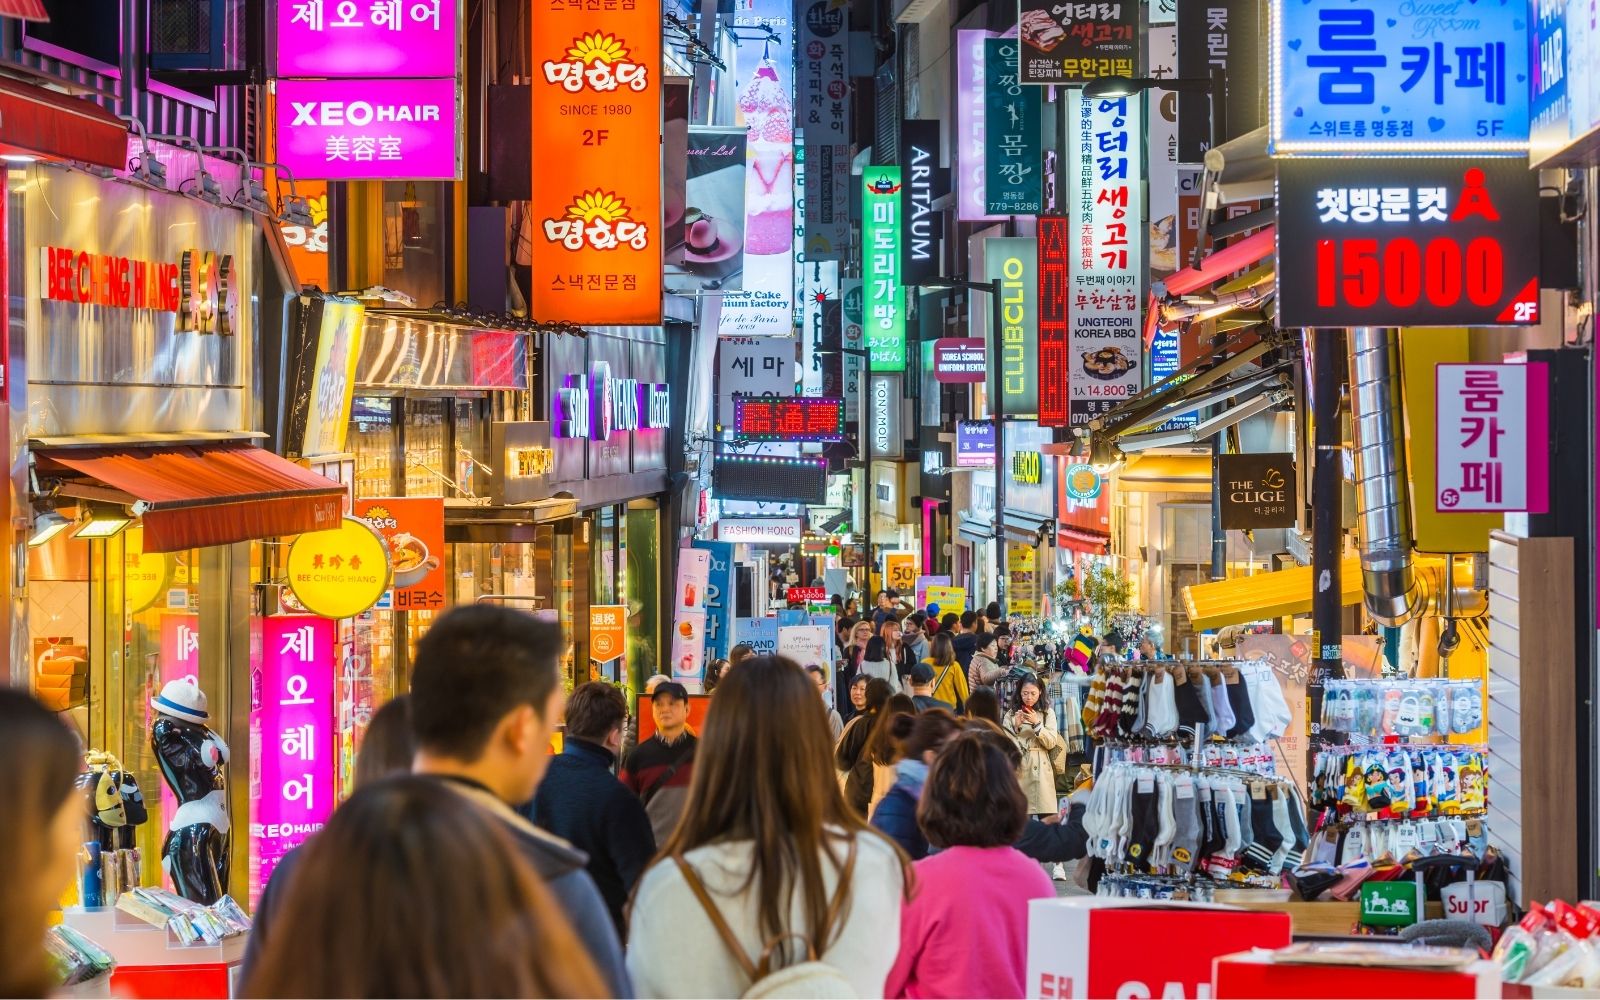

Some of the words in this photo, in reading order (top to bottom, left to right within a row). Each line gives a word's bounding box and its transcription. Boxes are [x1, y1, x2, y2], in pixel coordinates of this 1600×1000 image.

[290, 0, 441, 31] 제오헤어
[1052, 3, 1121, 26] 엉터리
[1071, 23, 1133, 47] 생고기
[1306, 9, 1387, 105] 룸
[1400, 41, 1506, 105] 카페
[544, 60, 648, 92] 명화당
[1063, 58, 1133, 78] 무한리필
[560, 105, 598, 116] SINCE
[602, 105, 632, 116] 1980
[582, 129, 609, 146] 2F
[1308, 120, 1367, 138] 스위트룸
[1371, 119, 1414, 138] 명동점
[1476, 120, 1504, 137] 5F
[326, 135, 403, 162] 美容室
[998, 134, 1032, 185] 몸짱
[911, 146, 931, 260] ARITAUM
[989, 202, 1039, 211] 779-8286
[1317, 187, 1411, 223] 첫방문
[1416, 187, 1448, 222] 컷
[544, 219, 648, 250] 명화당
[1097, 186, 1128, 270] 생고기
[43, 246, 74, 301] BEE
[873, 201, 897, 330] 미도리가방
[1316, 235, 1504, 309] 15000
[551, 274, 637, 291] 스낵전문점
[1075, 275, 1105, 286] 두번째
[1106, 275, 1135, 286] 이야기
[750, 299, 789, 309] factory
[754, 291, 781, 299] Cake
[750, 313, 778, 324] Paris
[1514, 302, 1537, 321] 2F
[1077, 317, 1132, 327] UNGTEORI
[869, 337, 899, 348] みどり
[1074, 329, 1111, 339] KOREA
[1113, 329, 1136, 340] BBQ
[942, 353, 962, 361] KOREA
[962, 353, 985, 361] SCHOOL
[877, 381, 887, 451] TONYMOLY
[1459, 370, 1505, 504] 룸카페
[1229, 481, 1253, 490] THE
[1230, 491, 1285, 503] CLIGE
[1443, 491, 1459, 506] 5F
[724, 526, 764, 536] FASHION
[767, 526, 794, 536] HONG
[297, 574, 311, 582] BEE
[313, 574, 345, 583] CHENG
[347, 576, 377, 584] HIANG
[394, 590, 443, 607] 비국수
[280, 625, 315, 810] 제오헤어
